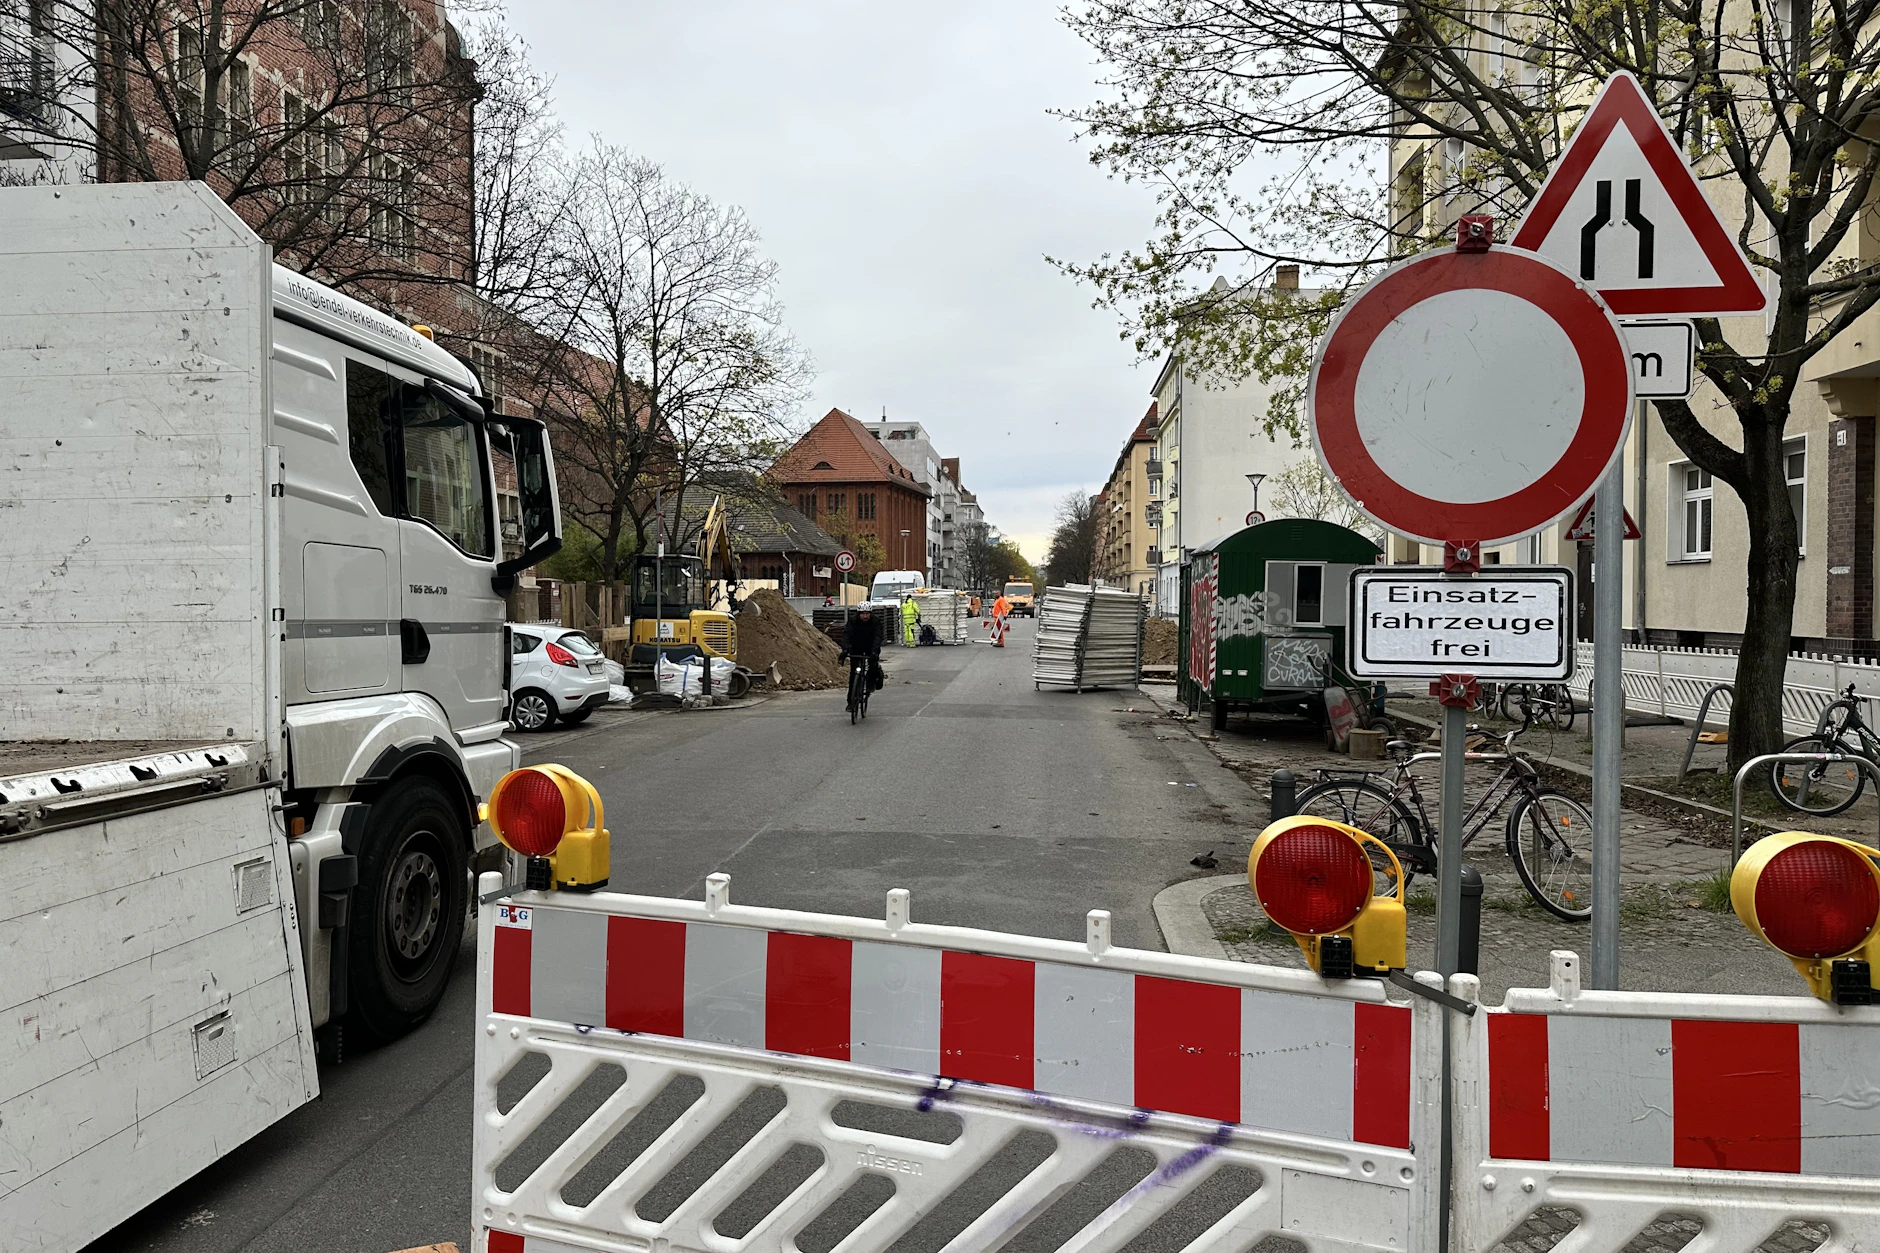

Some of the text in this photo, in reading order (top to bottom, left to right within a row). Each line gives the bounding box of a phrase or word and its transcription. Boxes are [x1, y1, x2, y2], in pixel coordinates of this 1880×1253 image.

[1631, 352, 1662, 377] m
[1388, 585, 1537, 604] Einsatz-
[1370, 612, 1554, 635] fahrzeuge
[1430, 639, 1490, 657] frei
[856, 1143, 923, 1176] nissen
